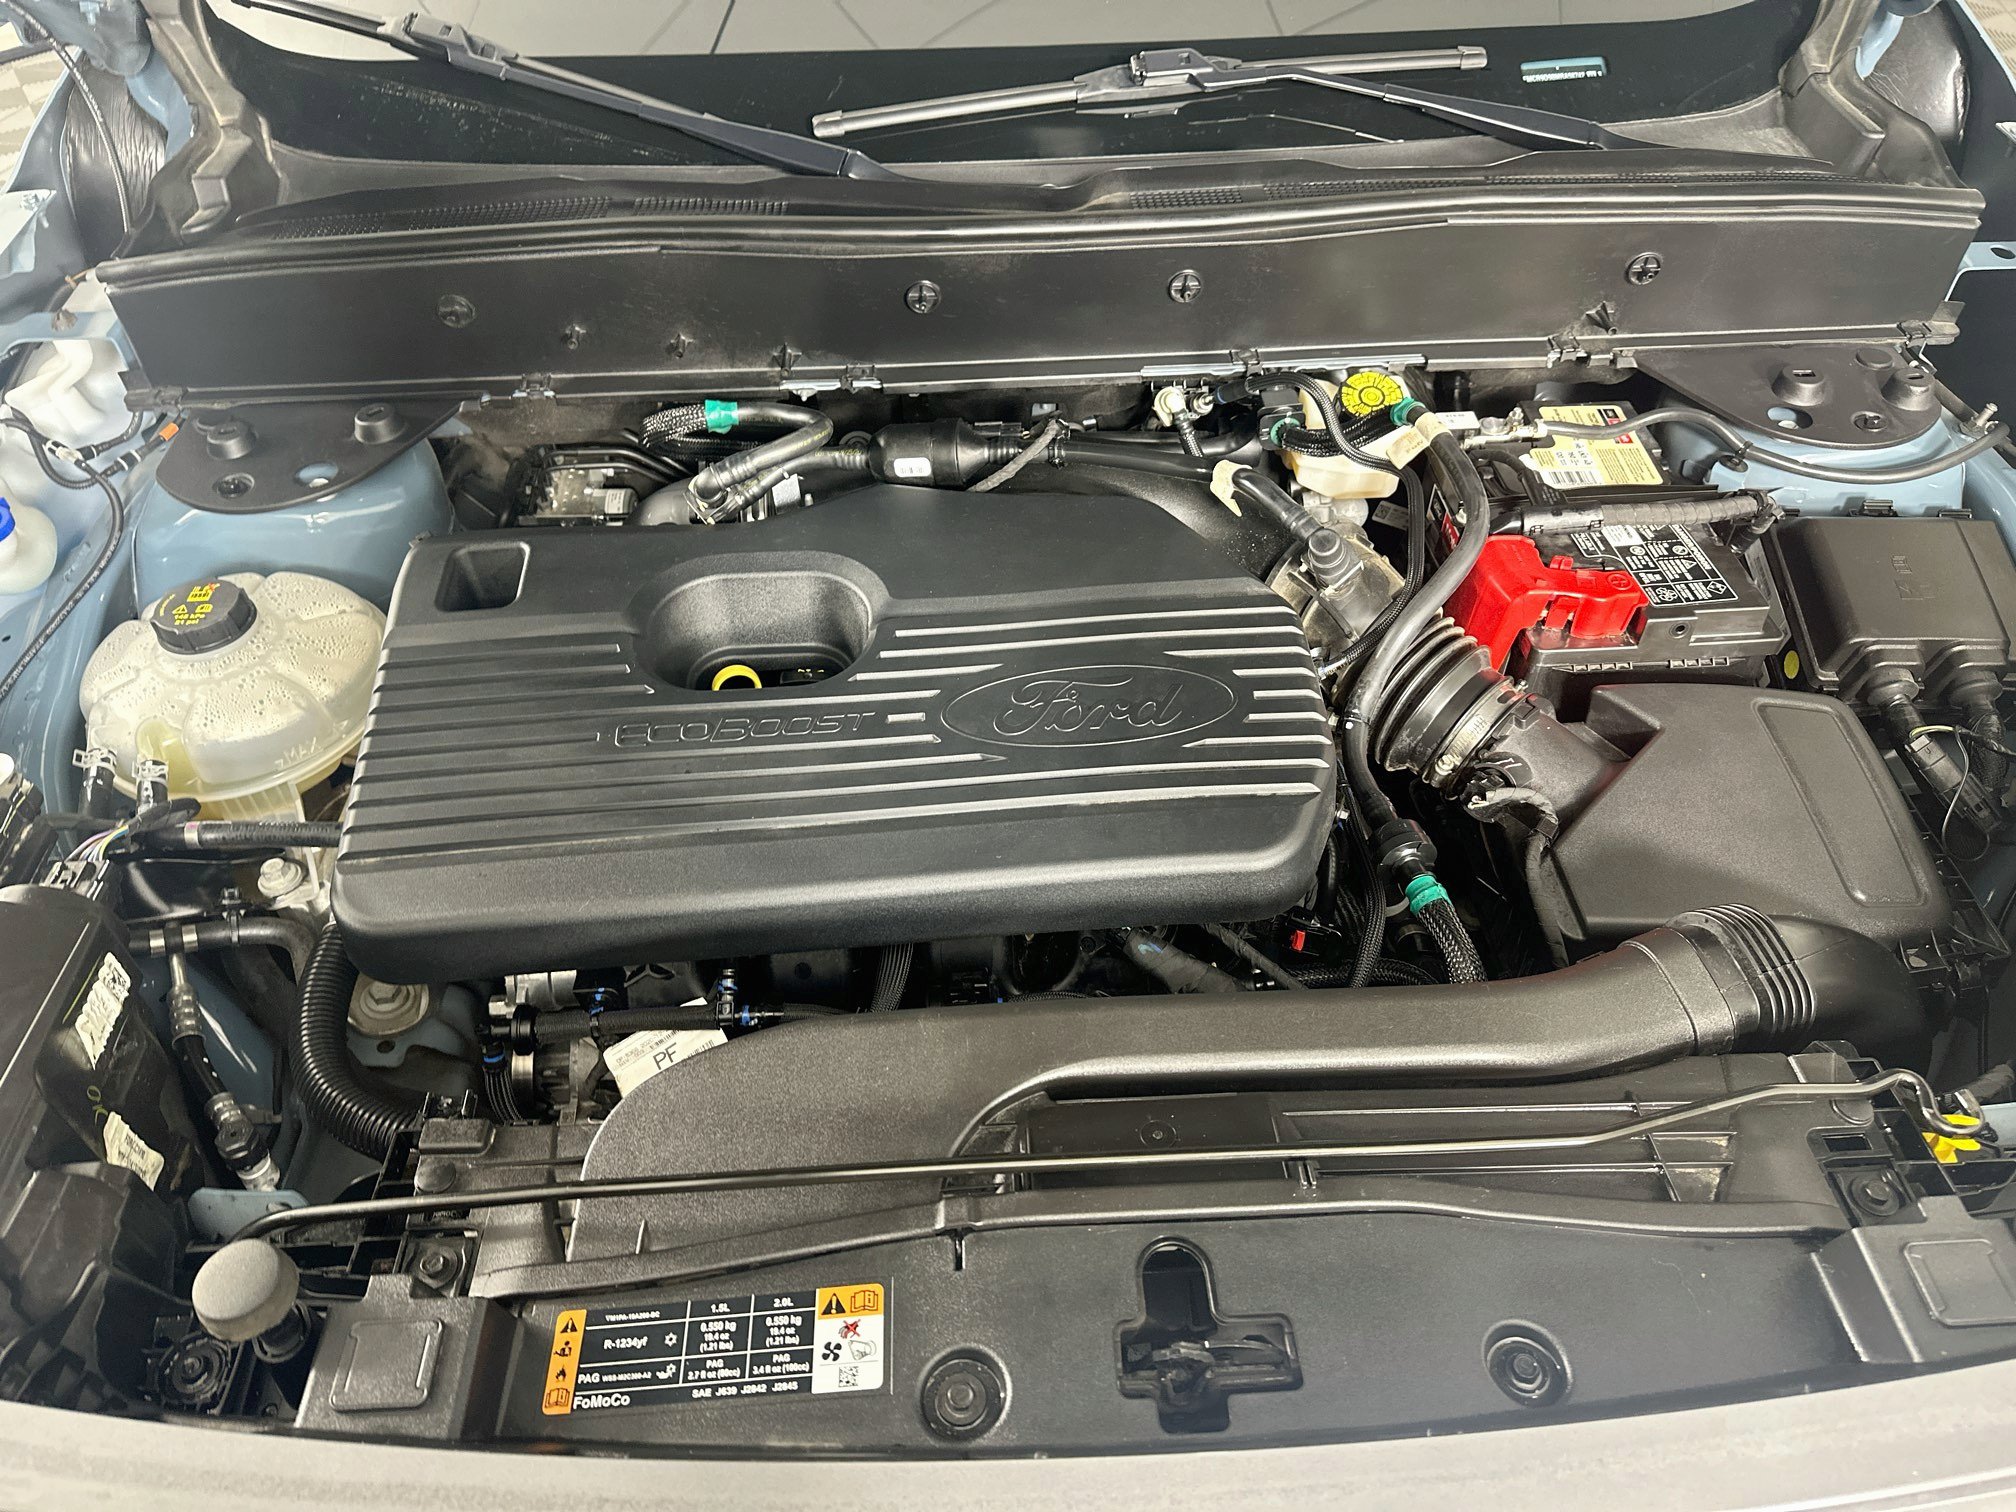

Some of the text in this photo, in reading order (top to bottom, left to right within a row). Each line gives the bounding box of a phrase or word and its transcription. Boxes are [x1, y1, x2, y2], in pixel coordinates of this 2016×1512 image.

[993, 674, 1183, 736] Ford
[653, 1042, 677, 1070] PF
[773, 1298, 794, 1308] 2.0L
[700, 1320, 737, 1332] 0.550 kg
[765, 1314, 803, 1327] 0.550 kg
[603, 1336, 648, 1349] R-1234yf
[706, 1359, 724, 1368] PAG
[772, 1353, 790, 1363] PAG
[772, 1365, 781, 1373] oz
[577, 1372, 600, 1384] PAG
[691, 1388, 712, 1398] SAE
[573, 1393, 631, 1410] FoMoCo
